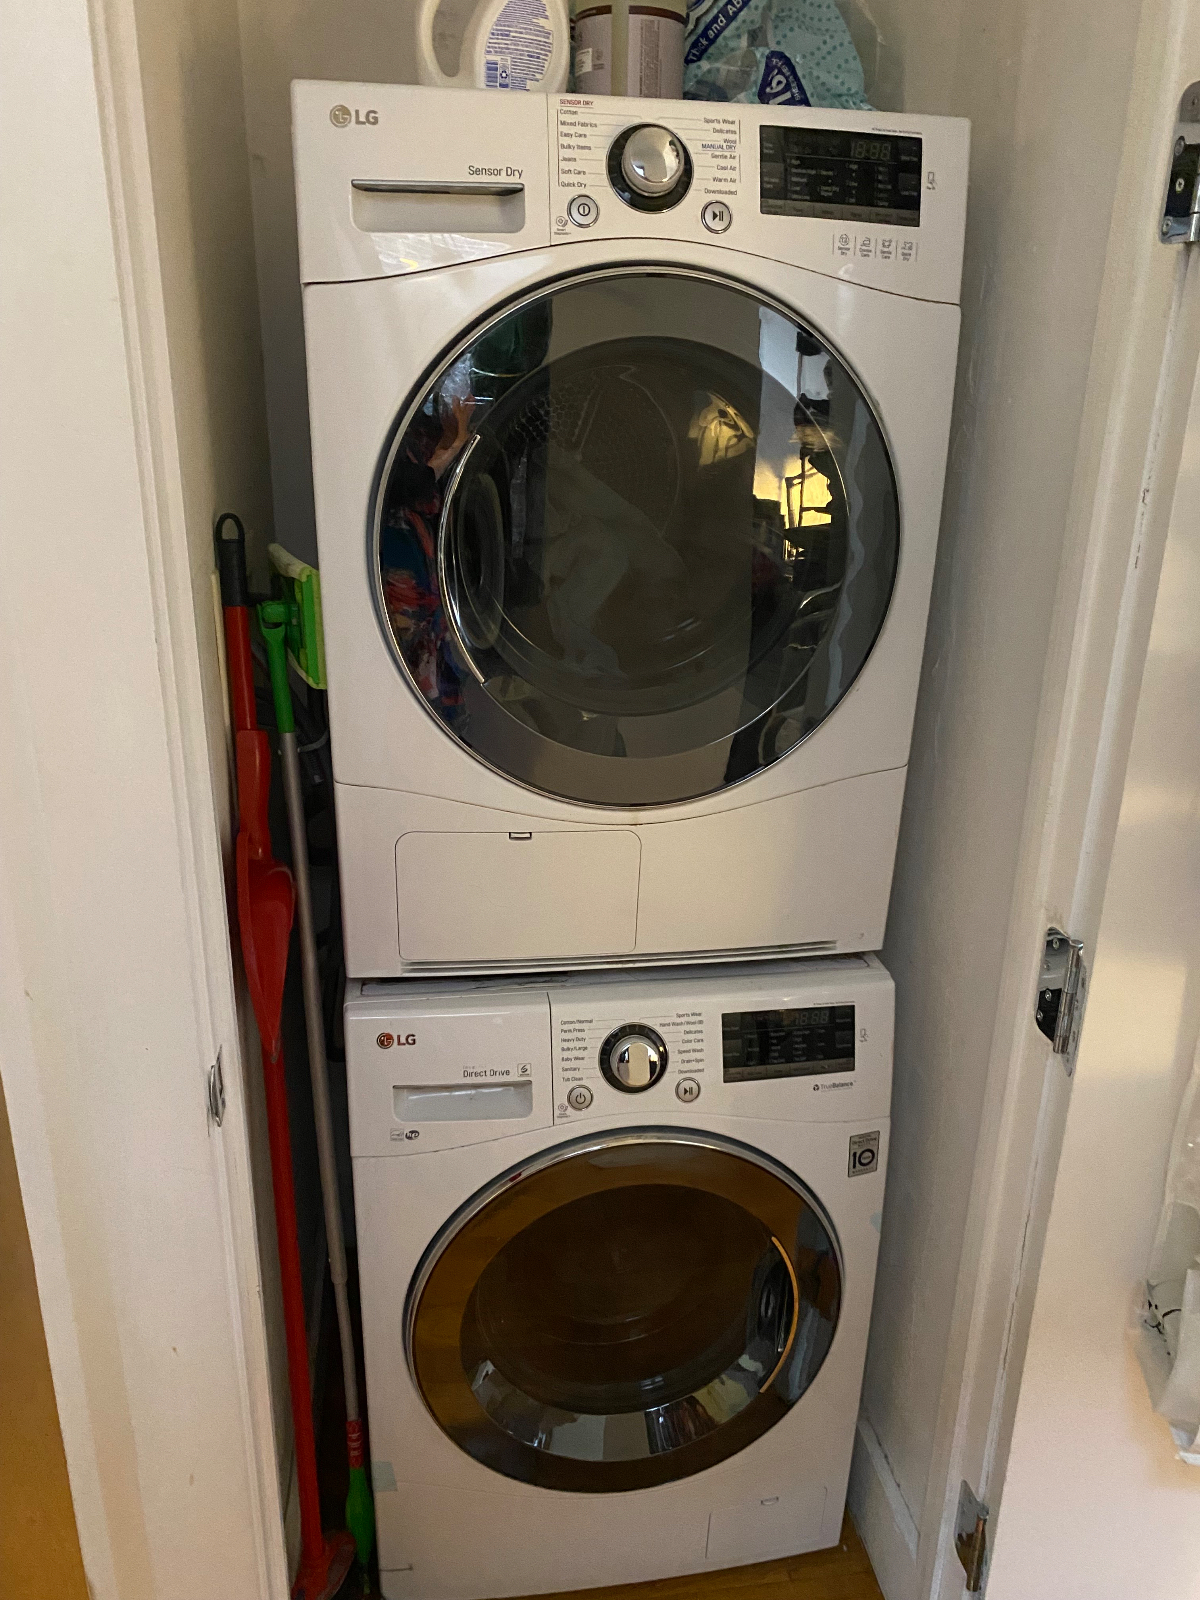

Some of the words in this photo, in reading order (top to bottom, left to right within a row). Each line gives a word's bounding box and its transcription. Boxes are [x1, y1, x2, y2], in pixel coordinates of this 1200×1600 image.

[708, 13, 727, 39] and
[354, 109, 379, 126] LG
[703, 117, 721, 125] Sports
[560, 143, 576, 151] Bulky
[468, 165, 503, 177] Sensor
[505, 166, 524, 179] Dry
[577, 181, 587, 189] Dry
[704, 188, 738, 196] Downloaded
[560, 1018, 594, 1026] Cotton/Normal
[396, 1033, 416, 1046] LG
[561, 1045, 588, 1053] Bulky/Large
[463, 1069, 488, 1078] Direct
[489, 1068, 511, 1077] Drive
[820, 1081, 854, 1090] TrueBalance
